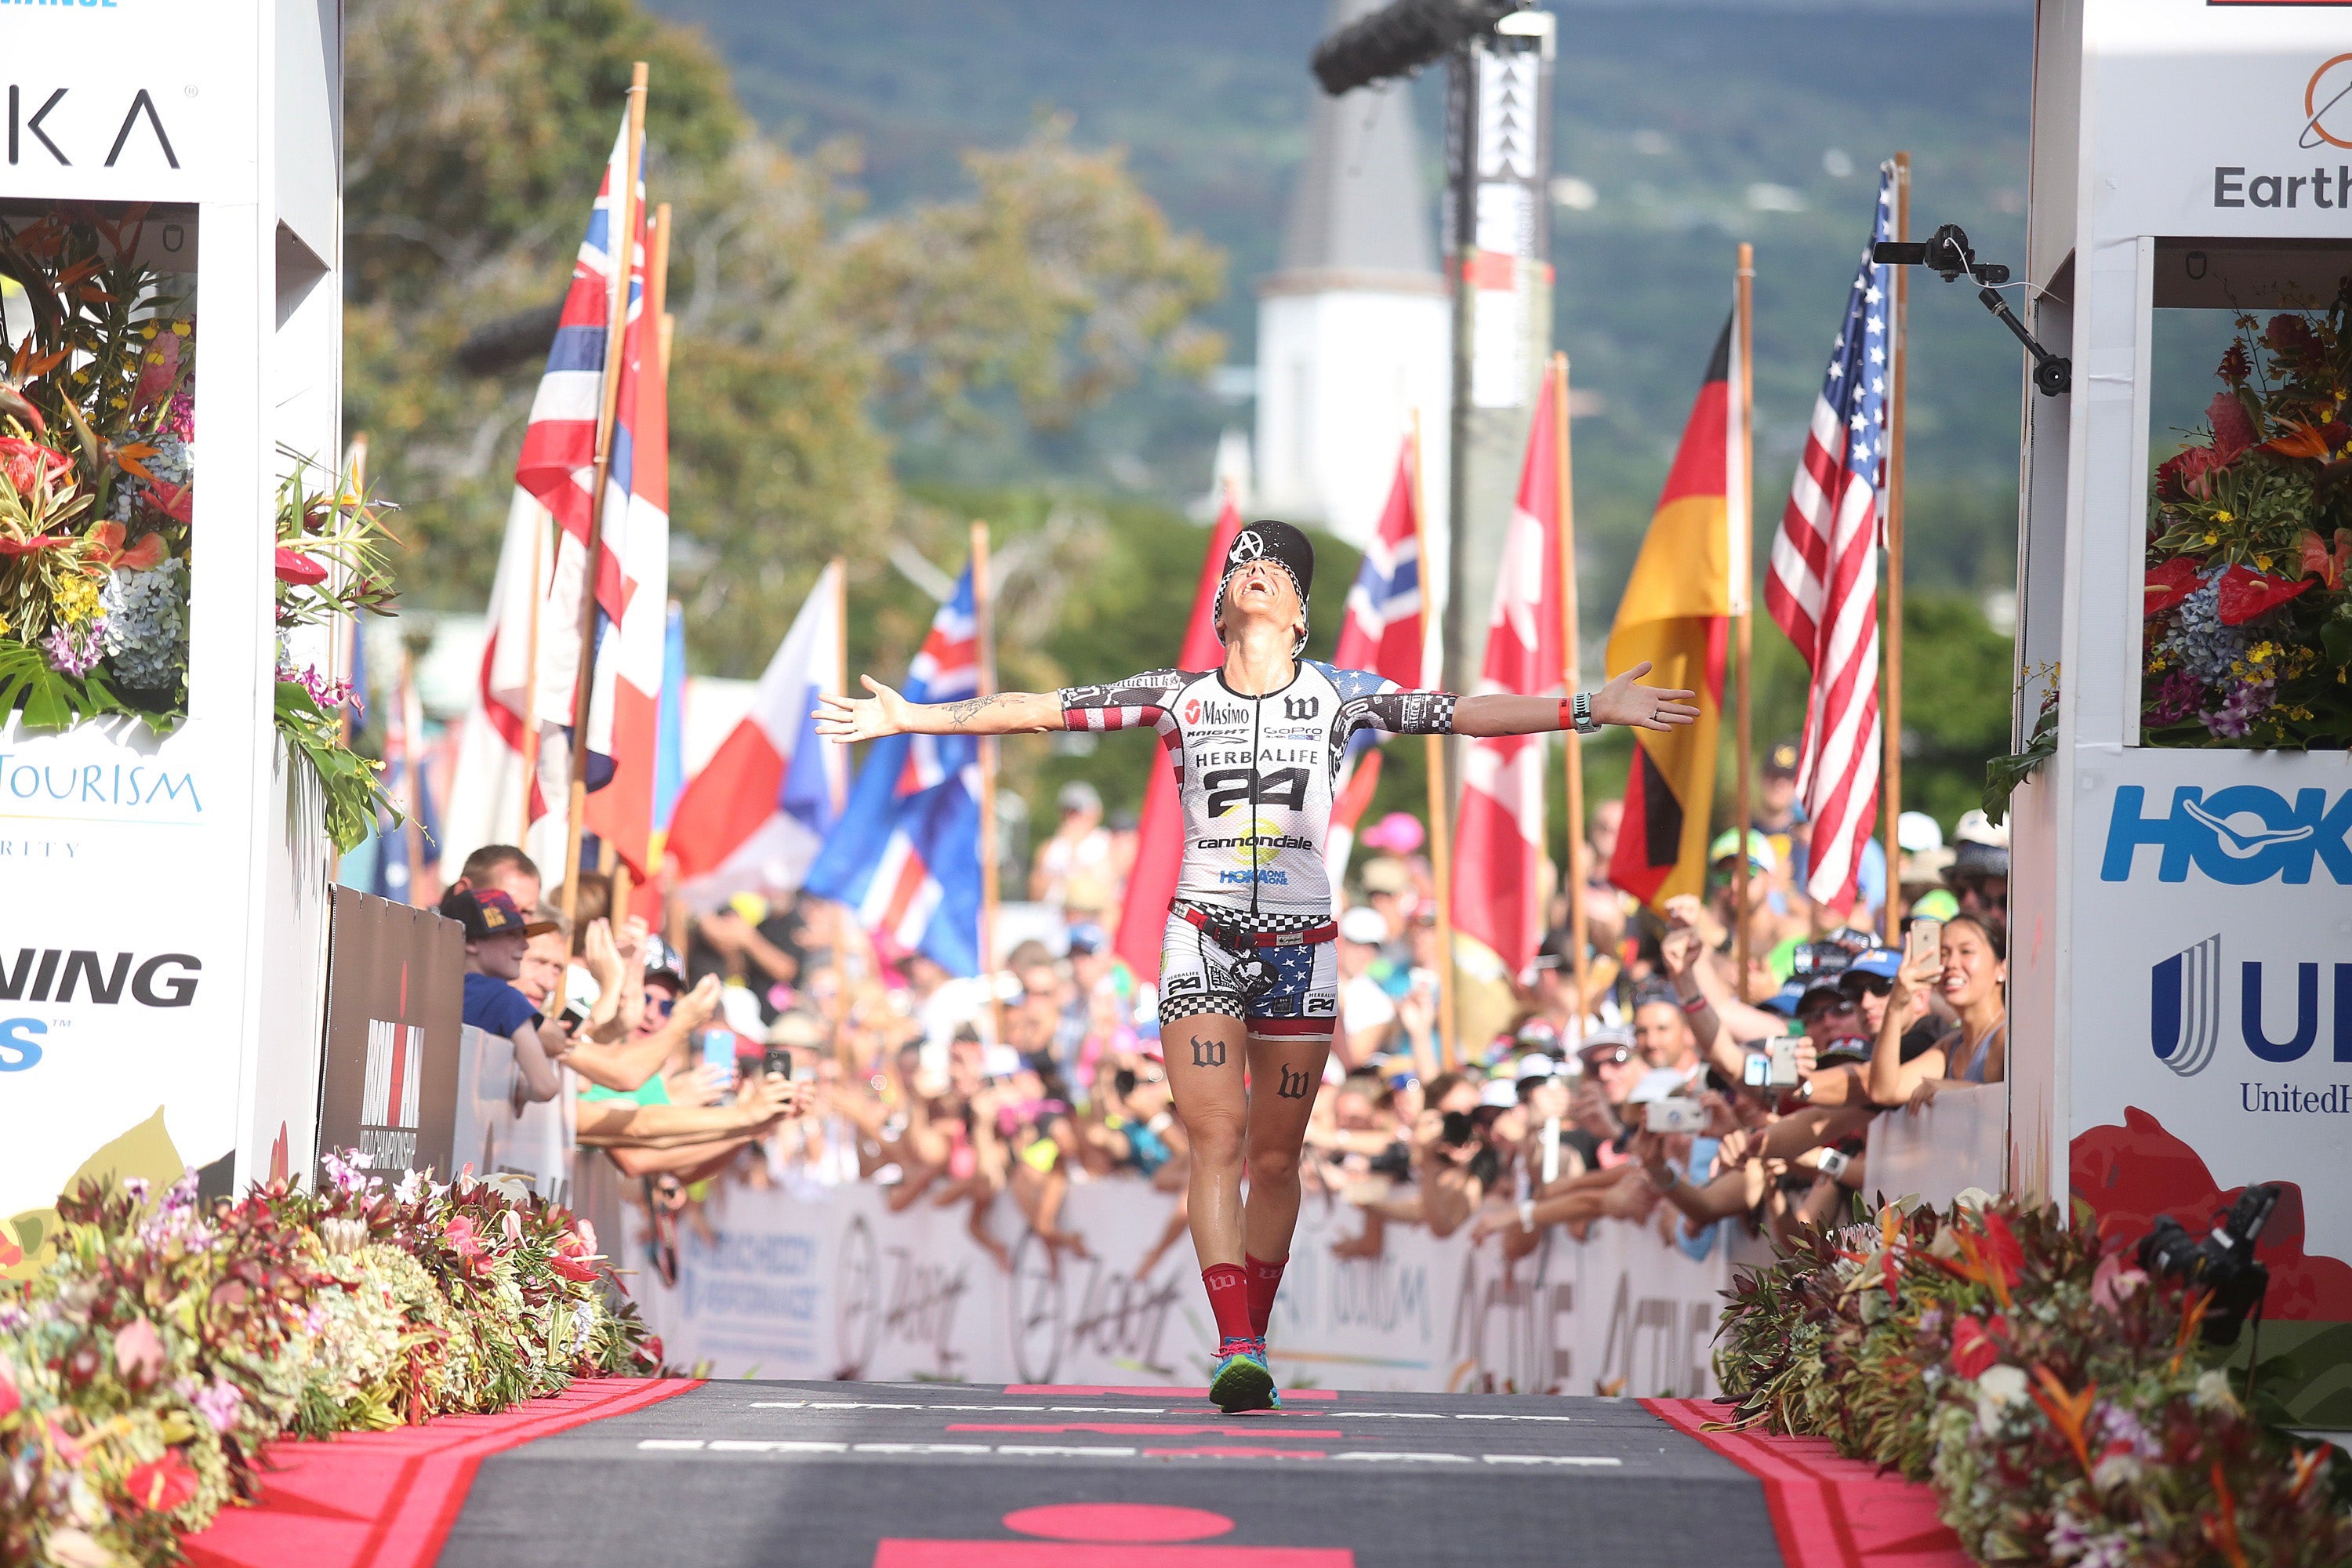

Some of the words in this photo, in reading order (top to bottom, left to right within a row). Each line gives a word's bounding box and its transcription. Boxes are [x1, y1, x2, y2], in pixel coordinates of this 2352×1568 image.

[1196, 749, 1318, 768] HERBALIFE
[1203, 768, 1310, 818] 24
[1198, 835, 1312, 850] cannondale
[1220, 869, 1269, 884] HOKA
[1167, 971, 1200, 981] HERBALIFE
[1168, 976, 1201, 996] 24
[1308, 998, 1335, 1012] 24
